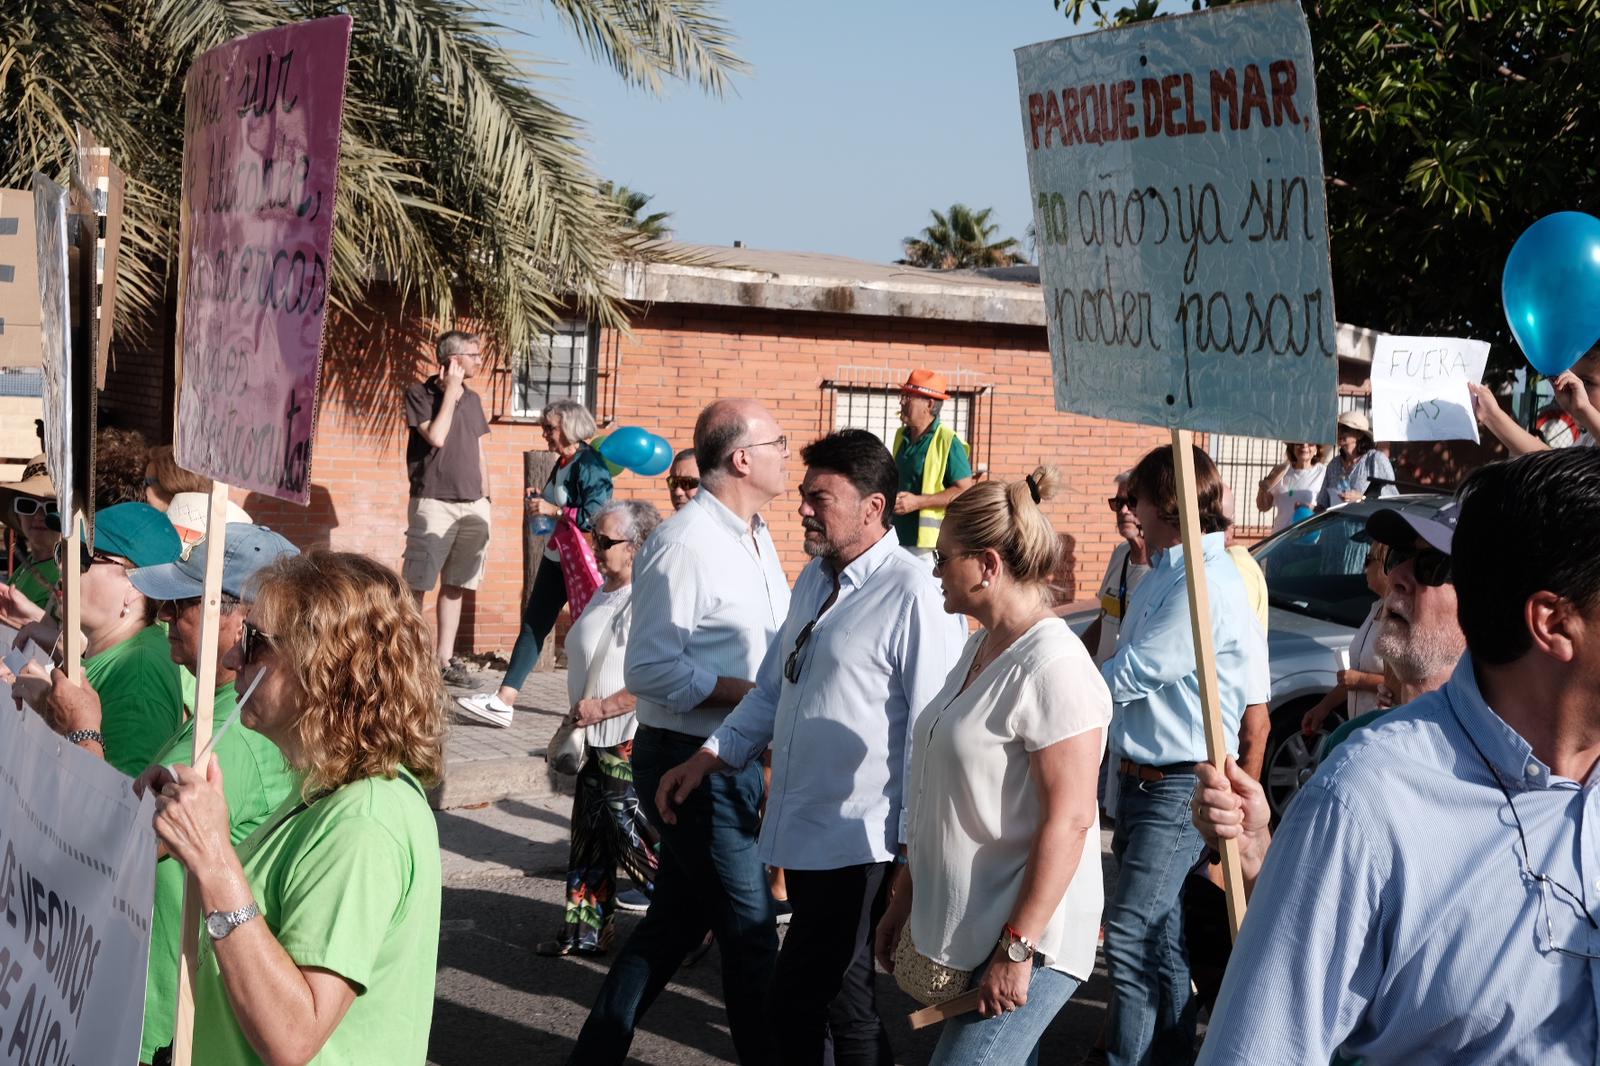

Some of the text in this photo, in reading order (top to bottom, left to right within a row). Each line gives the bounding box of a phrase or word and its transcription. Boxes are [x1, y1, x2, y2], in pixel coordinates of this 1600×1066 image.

[237, 49, 299, 119] sur
[1028, 59, 1309, 149] PARQUE DEL MAR,
[1038, 157, 1314, 285] 10 años ya sin
[1055, 255, 1334, 408] poder pasar
[1390, 349, 1470, 381] FUERA
